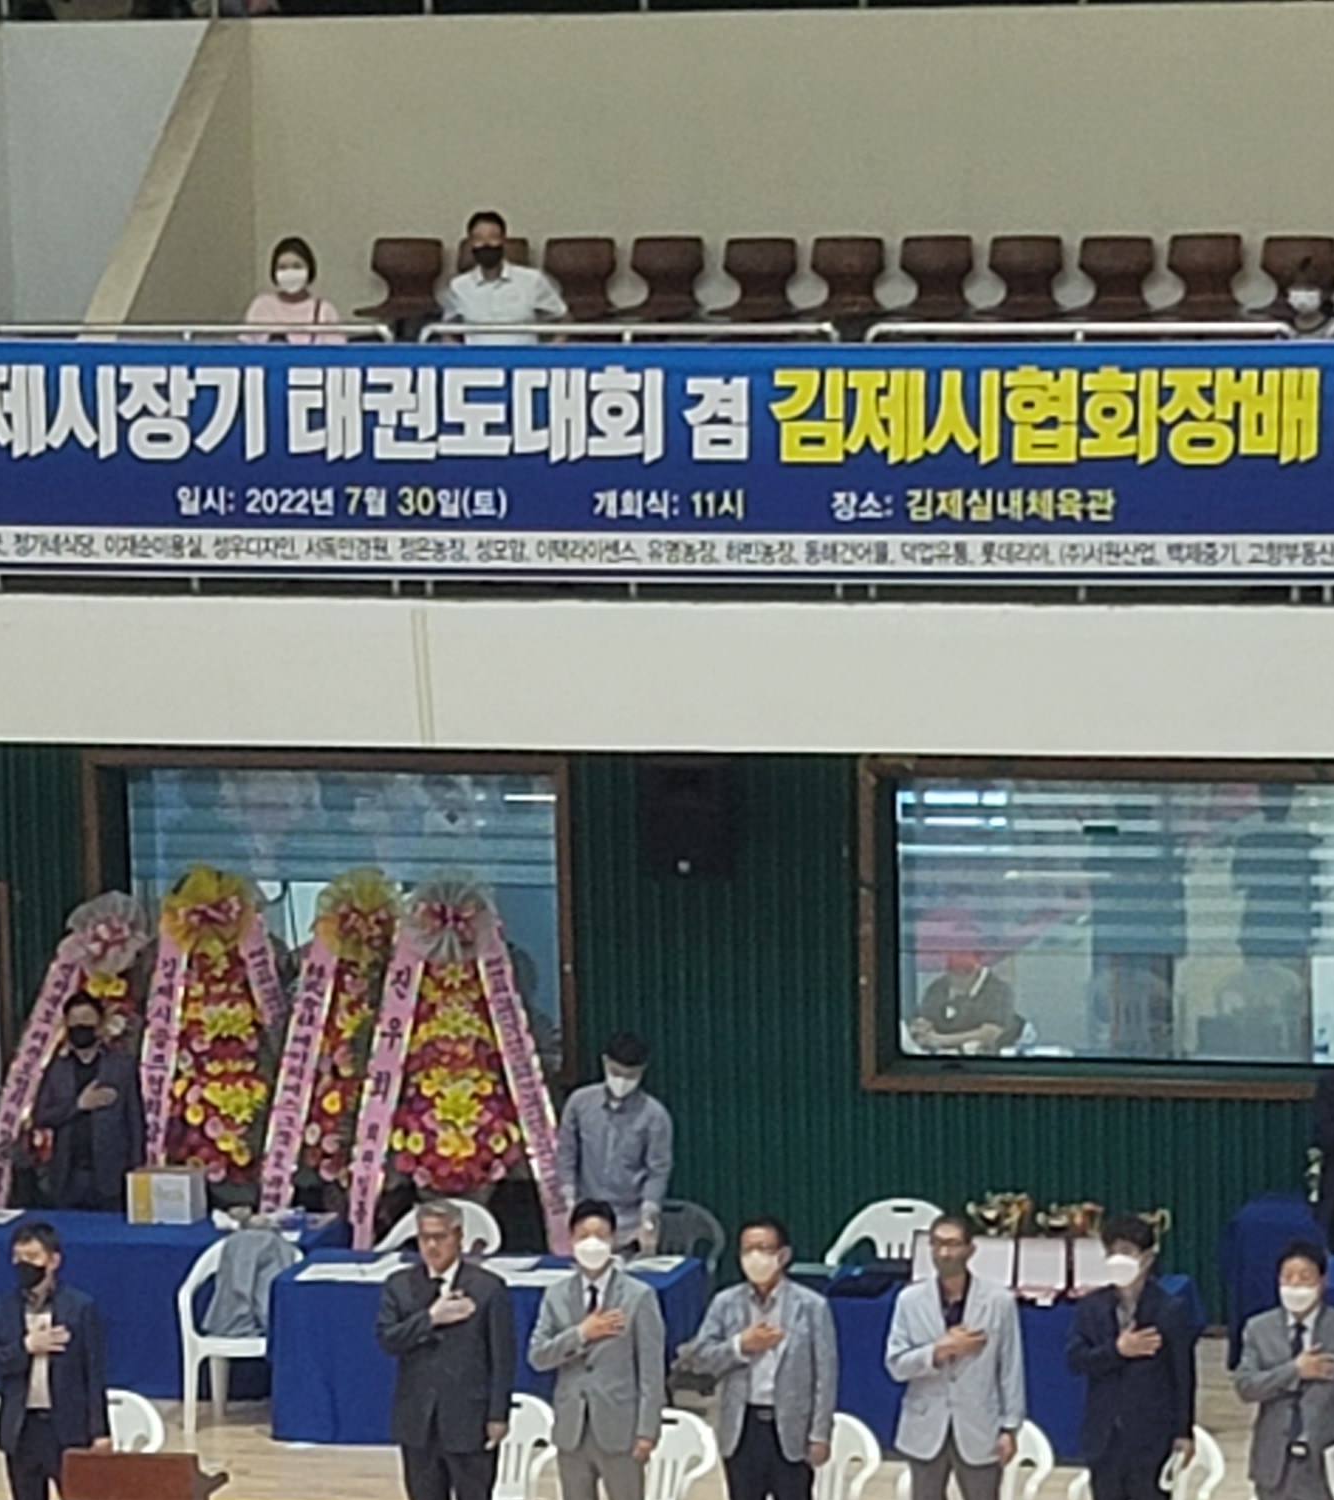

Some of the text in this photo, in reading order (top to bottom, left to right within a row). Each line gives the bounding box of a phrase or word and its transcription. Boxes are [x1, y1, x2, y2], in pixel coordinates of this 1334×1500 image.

[286, 365, 666, 464] 태권도대회
[682, 375, 750, 461] 겸
[771, 366, 1320, 465] 김제시협회장배
[176, 485, 508, 519] 일시: 2022년 7월 30일(토)
[592, 489, 745, 520] 개회식: 11시
[830, 488, 1116, 522] 장소: 김제실내체육관
[367, 965, 414, 1105] 진우회
